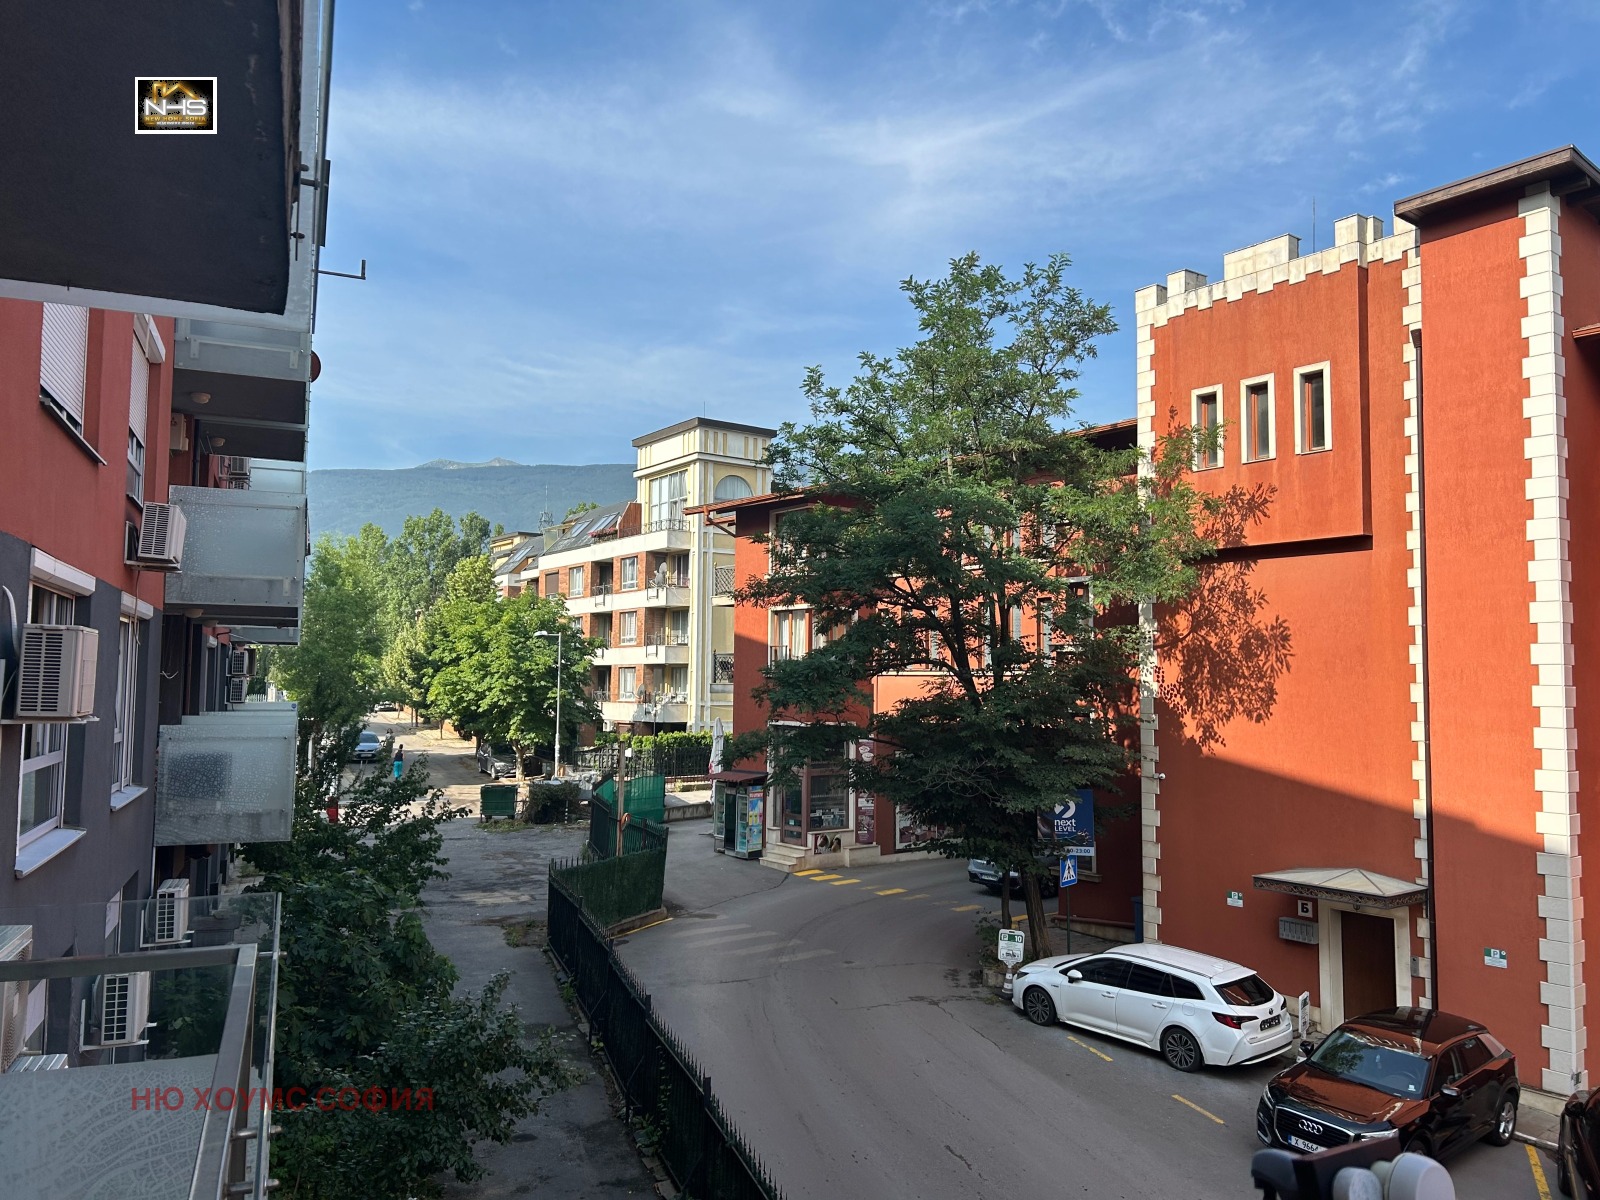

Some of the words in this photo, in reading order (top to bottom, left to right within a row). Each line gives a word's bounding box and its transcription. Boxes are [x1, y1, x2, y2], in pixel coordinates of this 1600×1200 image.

[1054, 818, 1077, 827] next
[1301, 902, 1310, 914] Б
[1014, 935, 1023, 943] 10
